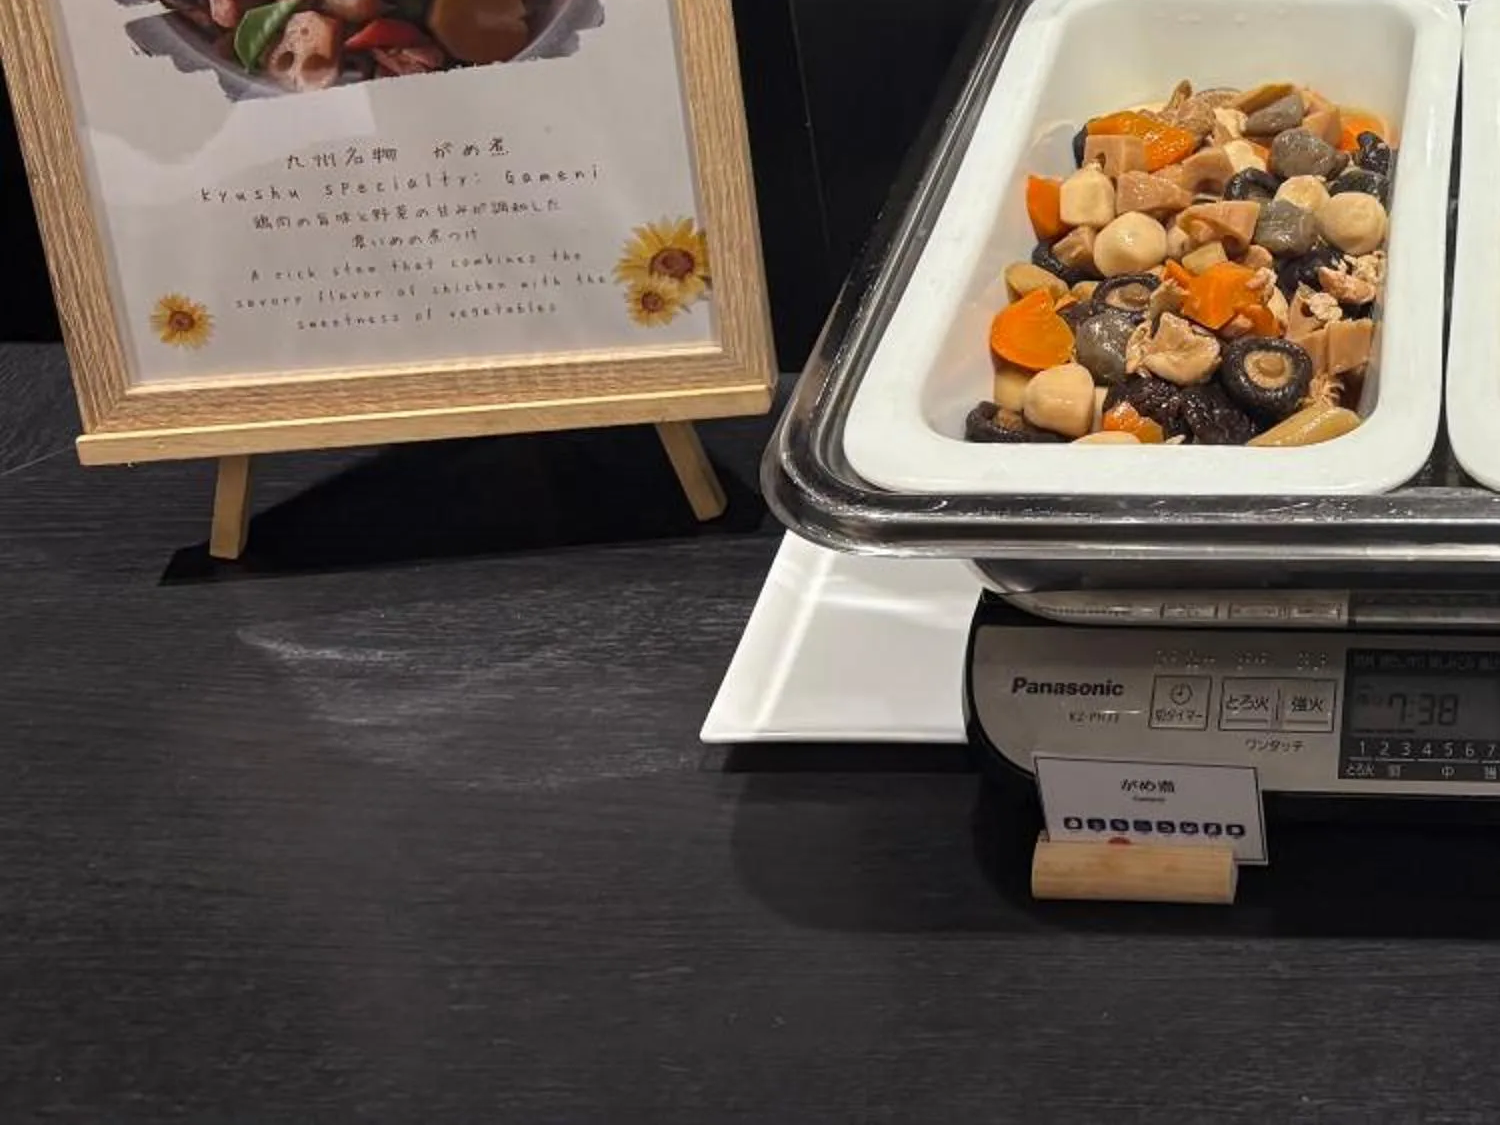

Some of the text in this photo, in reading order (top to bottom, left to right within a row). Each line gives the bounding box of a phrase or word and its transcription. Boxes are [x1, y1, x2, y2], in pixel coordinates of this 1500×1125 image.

[1011, 676, 1125, 697] Panasonic
[1225, 694, 1326, 713] とろ火 強火
[1245, 738, 1304, 753] ワンタッチ
[1379, 741, 1391, 756] 2
[1400, 741, 1412, 756] 3
[1421, 742, 1432, 756] 4
[1443, 742, 1454, 756] 5
[1464, 742, 1475, 756] 6
